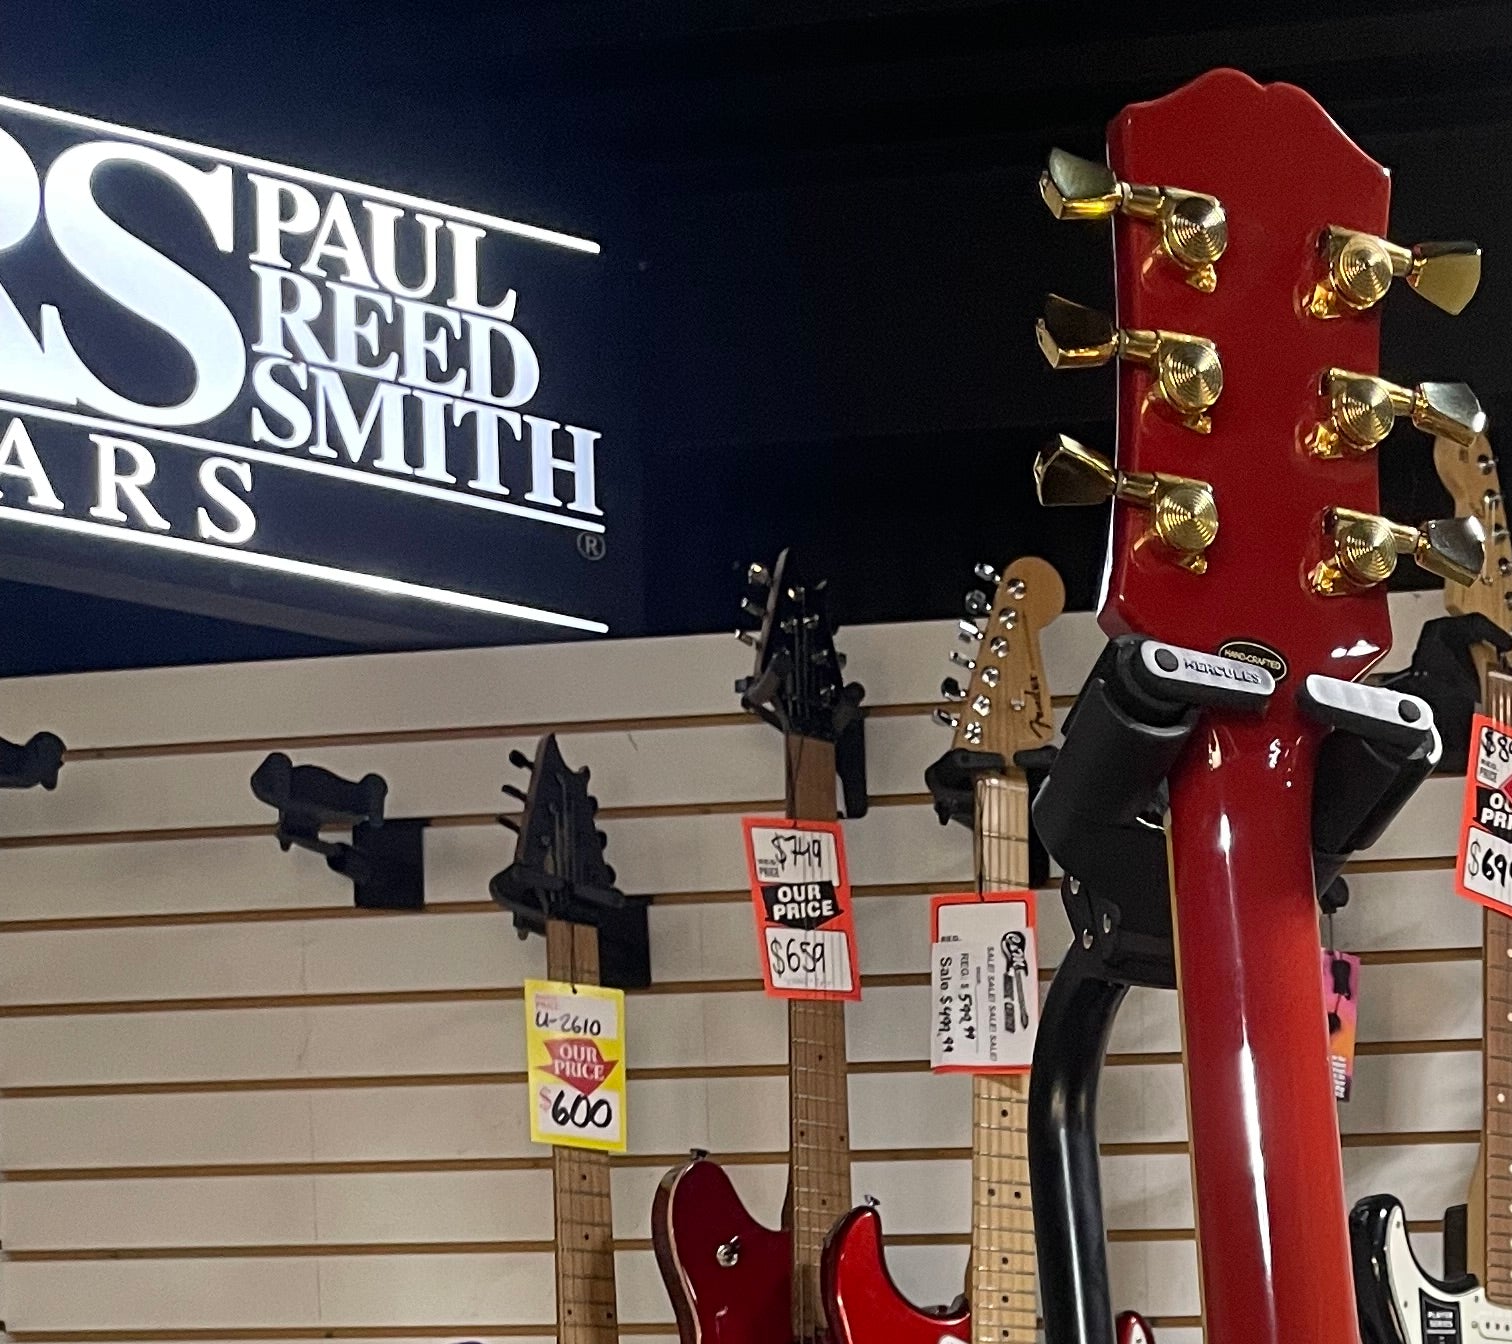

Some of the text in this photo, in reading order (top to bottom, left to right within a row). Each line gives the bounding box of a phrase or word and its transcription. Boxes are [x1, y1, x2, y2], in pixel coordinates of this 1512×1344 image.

[248, 173, 517, 322] PAUL
[250, 262, 541, 409] REED
[250, 358, 604, 516] SMITH
[1183, 658, 1262, 685] HERCULES
[777, 883, 822, 903] OUR
[772, 899, 836, 921] PRICE
[770, 936, 826, 978] $659
[940, 957, 953, 991] Sale
[559, 1043, 598, 1062] OUR
[553, 1059, 605, 1081] PRICE
